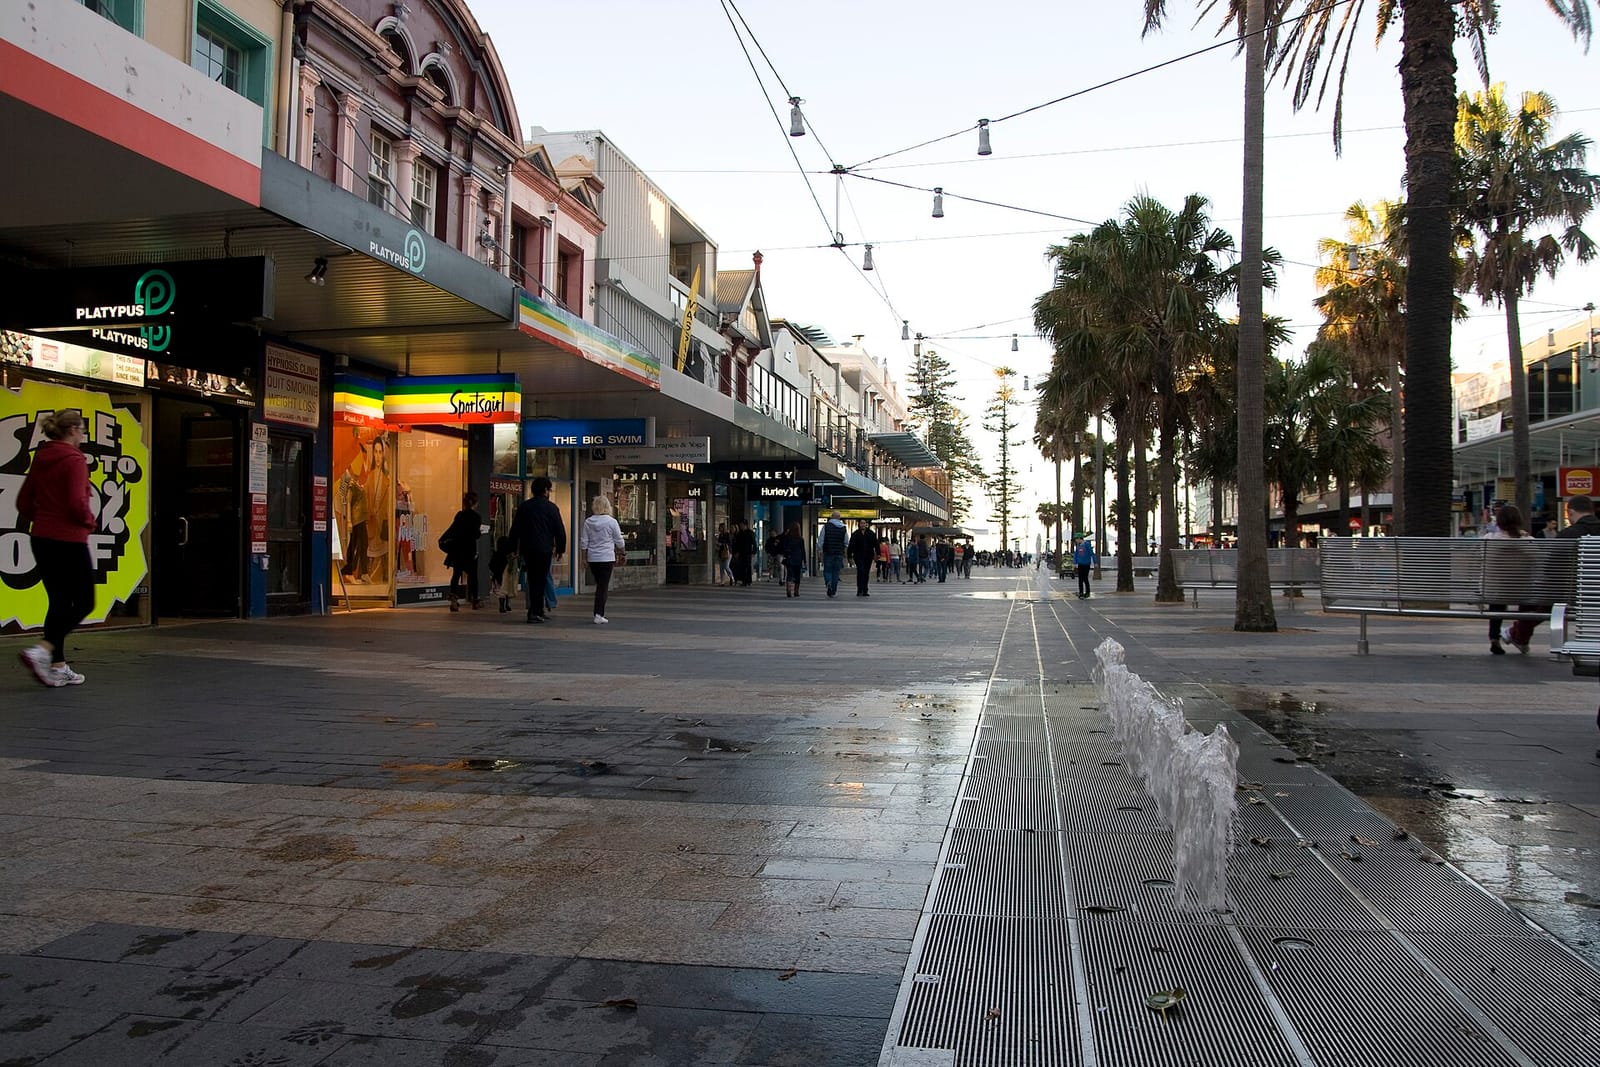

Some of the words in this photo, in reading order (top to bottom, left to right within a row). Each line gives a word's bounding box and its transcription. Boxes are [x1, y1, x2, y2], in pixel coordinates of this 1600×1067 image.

[369, 240, 410, 269] PLATYPUS
[76, 304, 145, 320] PLATYPUS
[92, 328, 149, 349] PLATYPUS
[267, 355, 299, 373] HYPNOSIS
[299, 363, 319, 377] CLINIC
[267, 375, 284, 391] QUIT
[286, 379, 318, 398] SMOKING
[268, 392, 297, 409] WEIGHT
[298, 399, 317, 414] LOSS
[448, 389, 505, 419] Sportsgirl
[552, 436, 578, 445] THE
[582, 435, 604, 445] BIG
[607, 435, 642, 444] SWIM
[100, 454, 136, 475] TO
[729, 471, 794, 480] OAKLEY
[761, 487, 789, 498] Hurley
